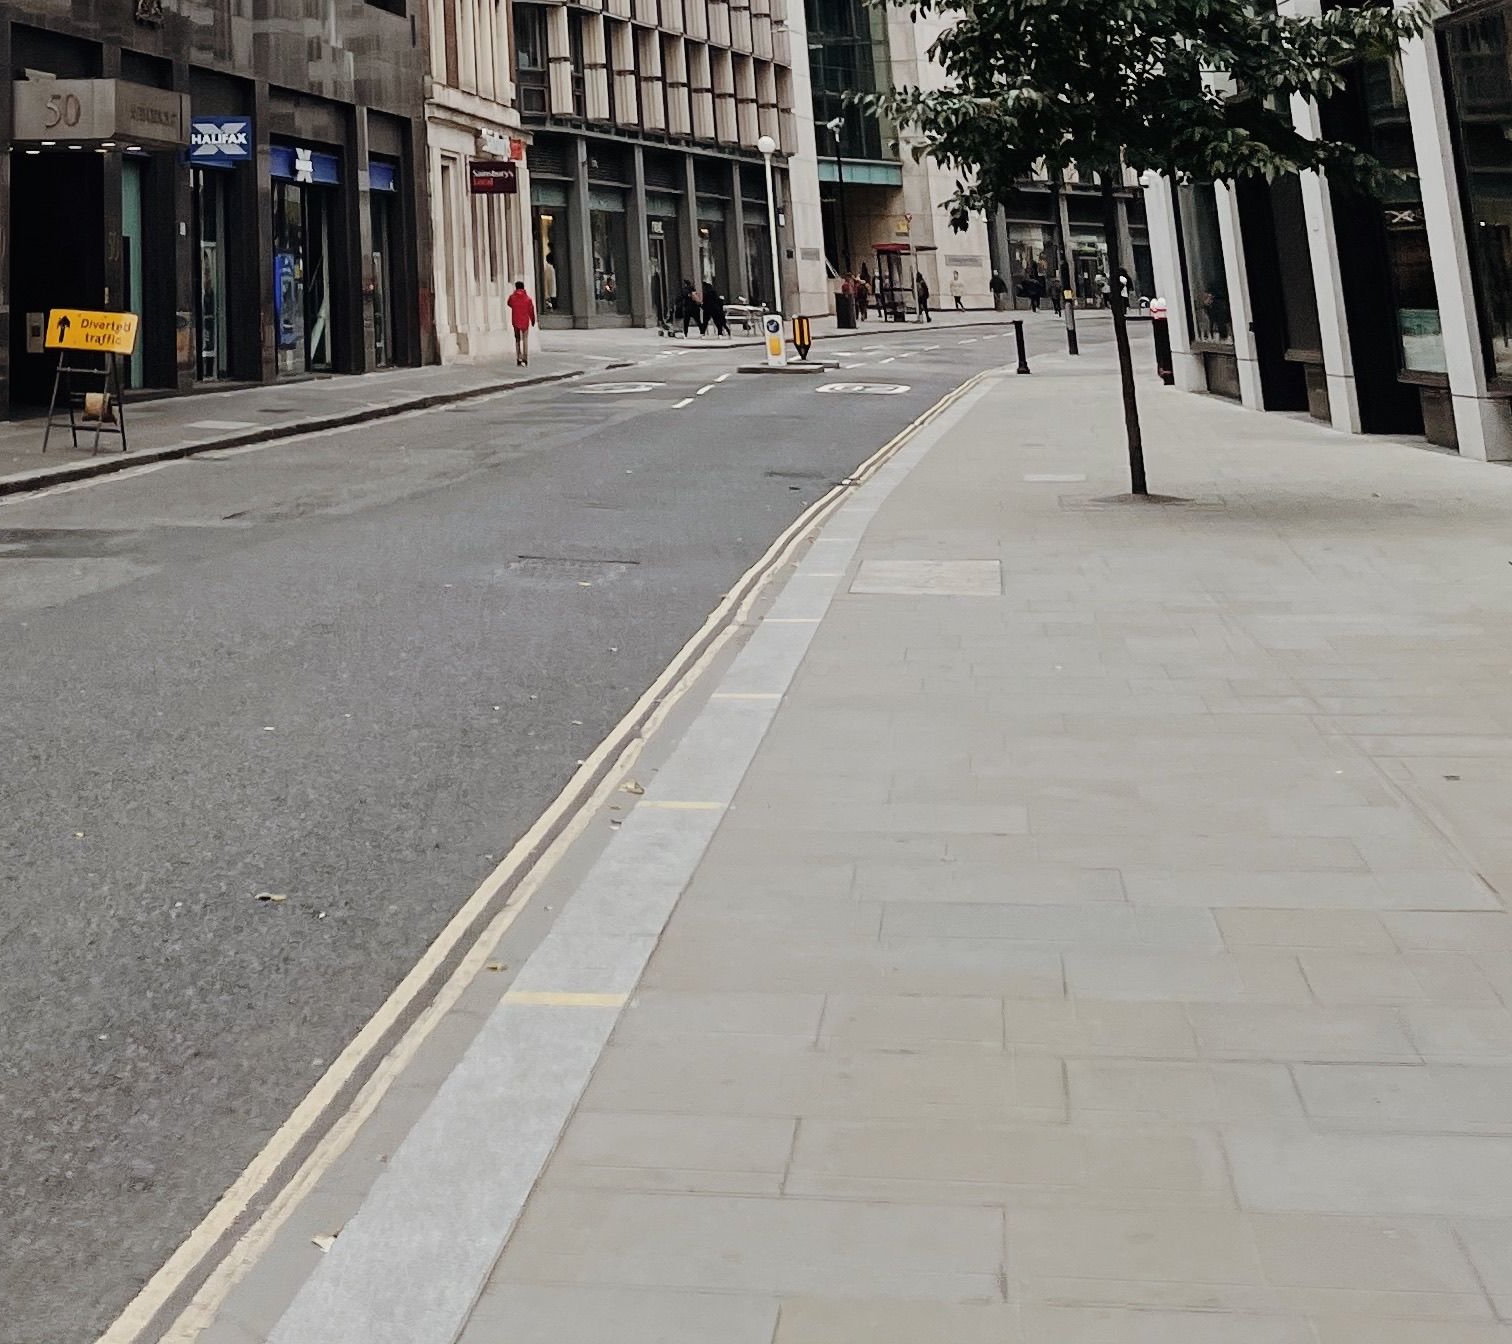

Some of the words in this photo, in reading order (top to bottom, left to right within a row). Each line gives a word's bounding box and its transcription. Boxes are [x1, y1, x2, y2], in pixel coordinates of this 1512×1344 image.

[45, 93, 81, 130] 50
[191, 132, 248, 146] HALIFAX
[80, 318, 132, 334] Diverted
[85, 333, 122, 346] traffic
